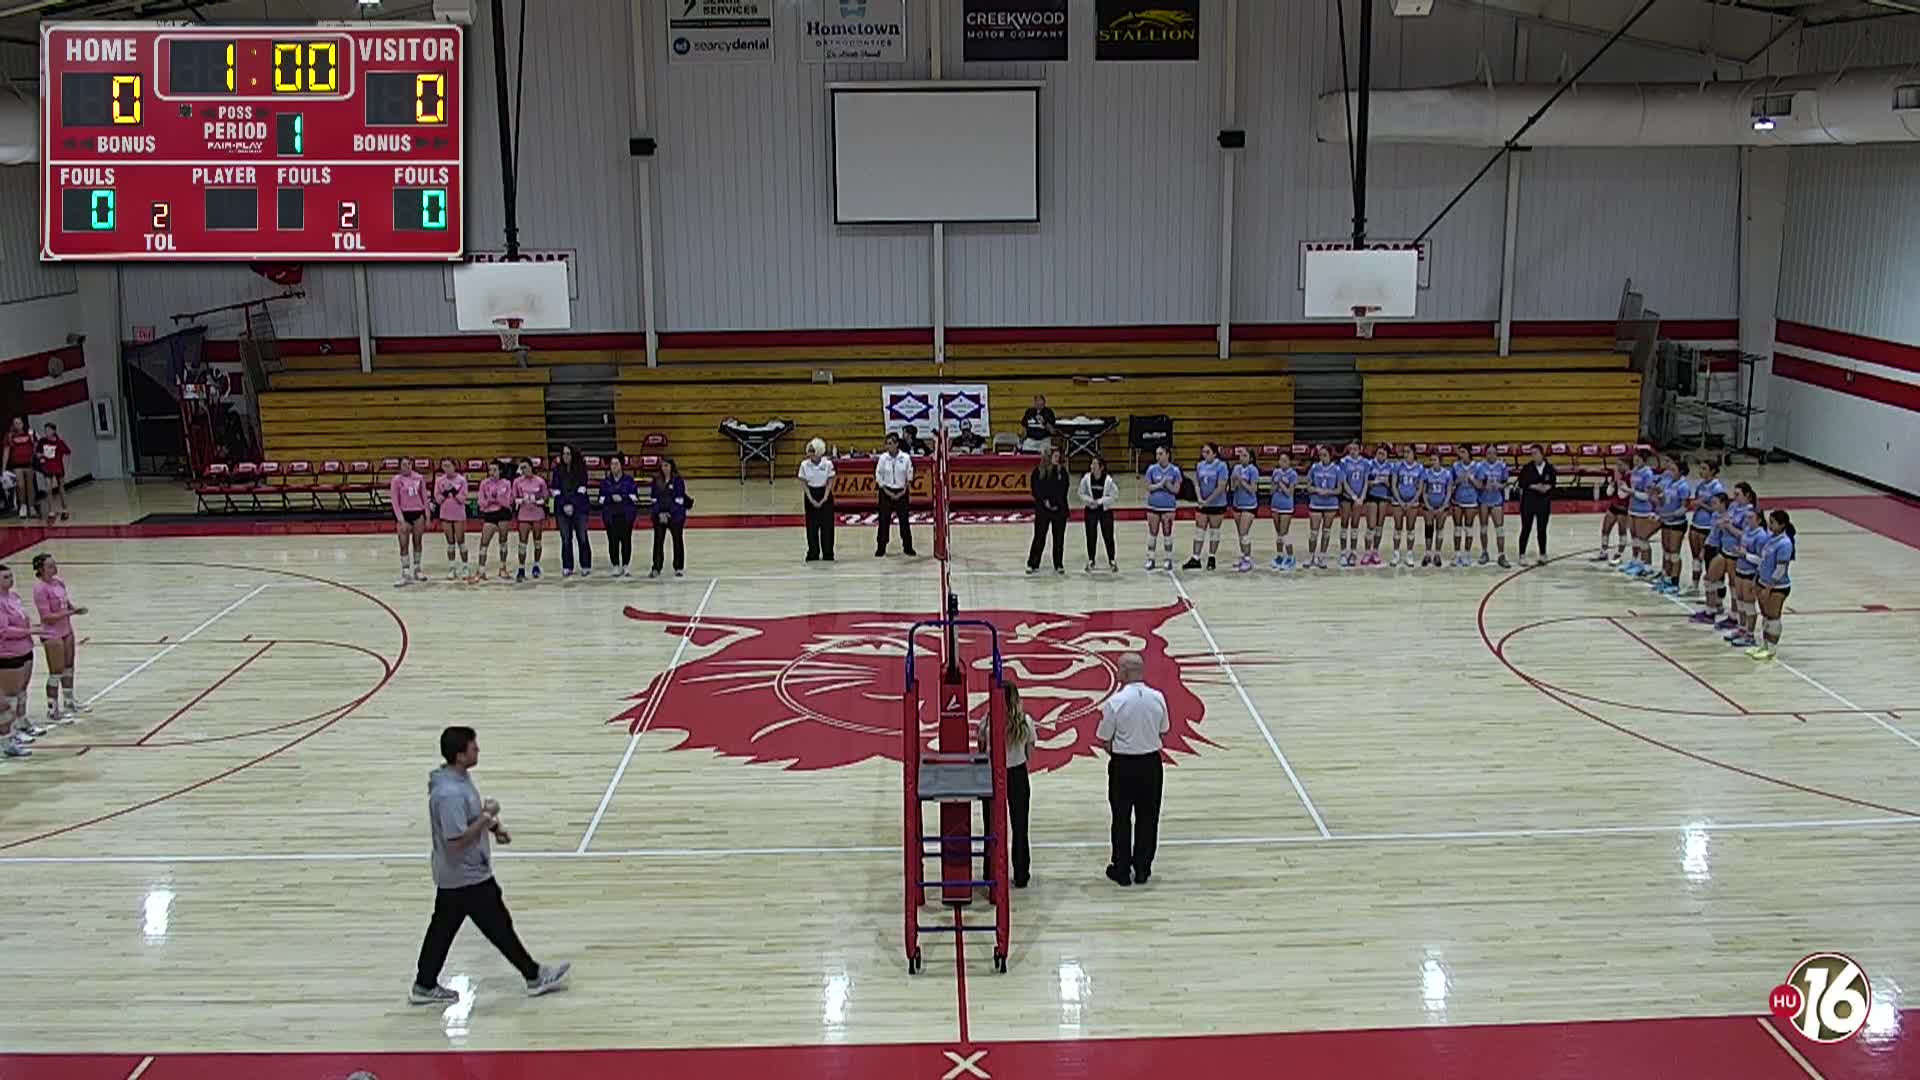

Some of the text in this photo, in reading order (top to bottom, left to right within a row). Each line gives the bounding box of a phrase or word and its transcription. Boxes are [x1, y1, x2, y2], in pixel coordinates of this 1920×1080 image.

[966, 11, 1065, 29] CREEKWOOD
[807, 21, 900, 35] Hometown
[1099, 30, 1195, 40] STALLION
[833, 476, 923, 492] HARG
[951, 474, 1028, 489] WILDCA
